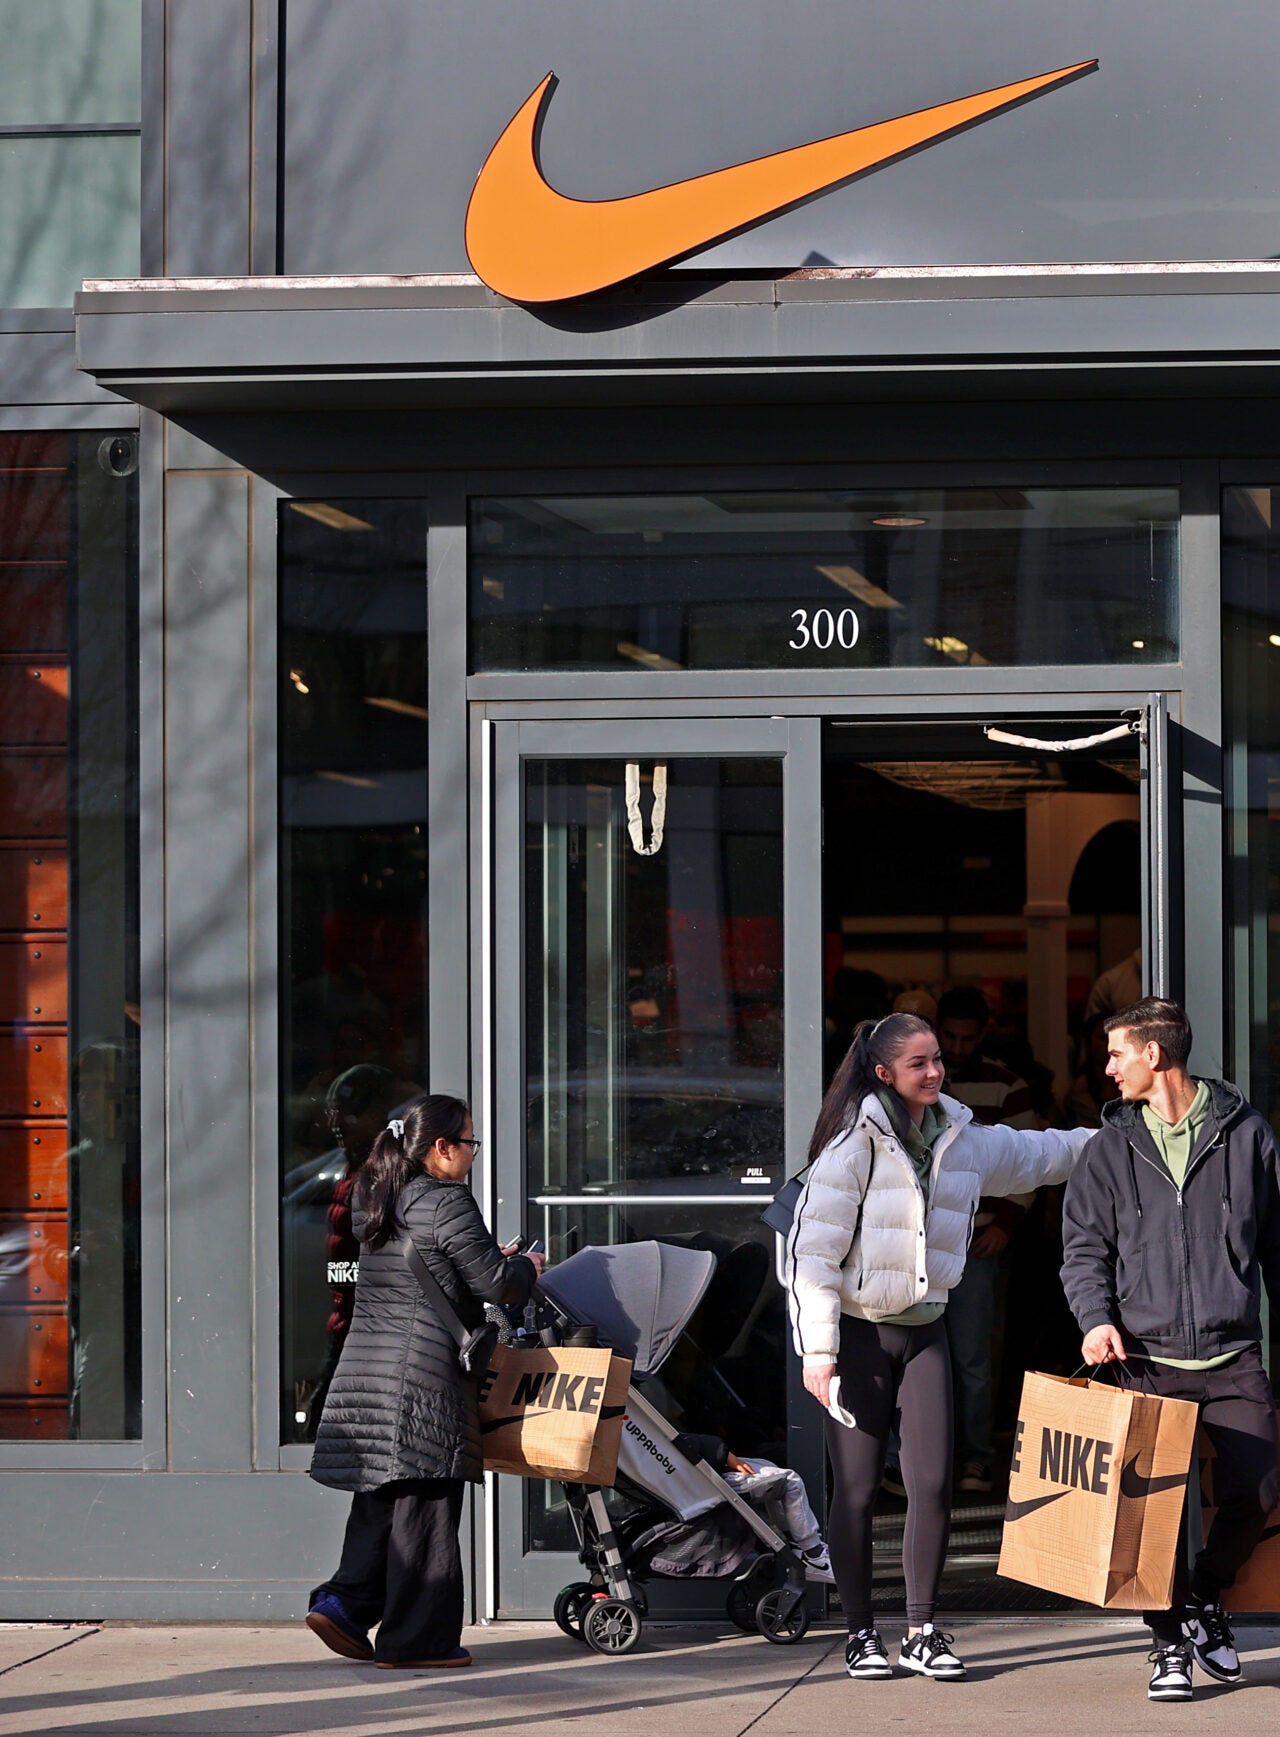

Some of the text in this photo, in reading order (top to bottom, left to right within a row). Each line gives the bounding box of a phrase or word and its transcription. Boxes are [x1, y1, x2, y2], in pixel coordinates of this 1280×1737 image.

[788, 608, 859, 650] 300
[746, 1167, 764, 1177] PULL
[327, 1261, 350, 1270] SHOP
[511, 1372, 606, 1414] NIKE
[1039, 1426, 1113, 1496] NIKE
